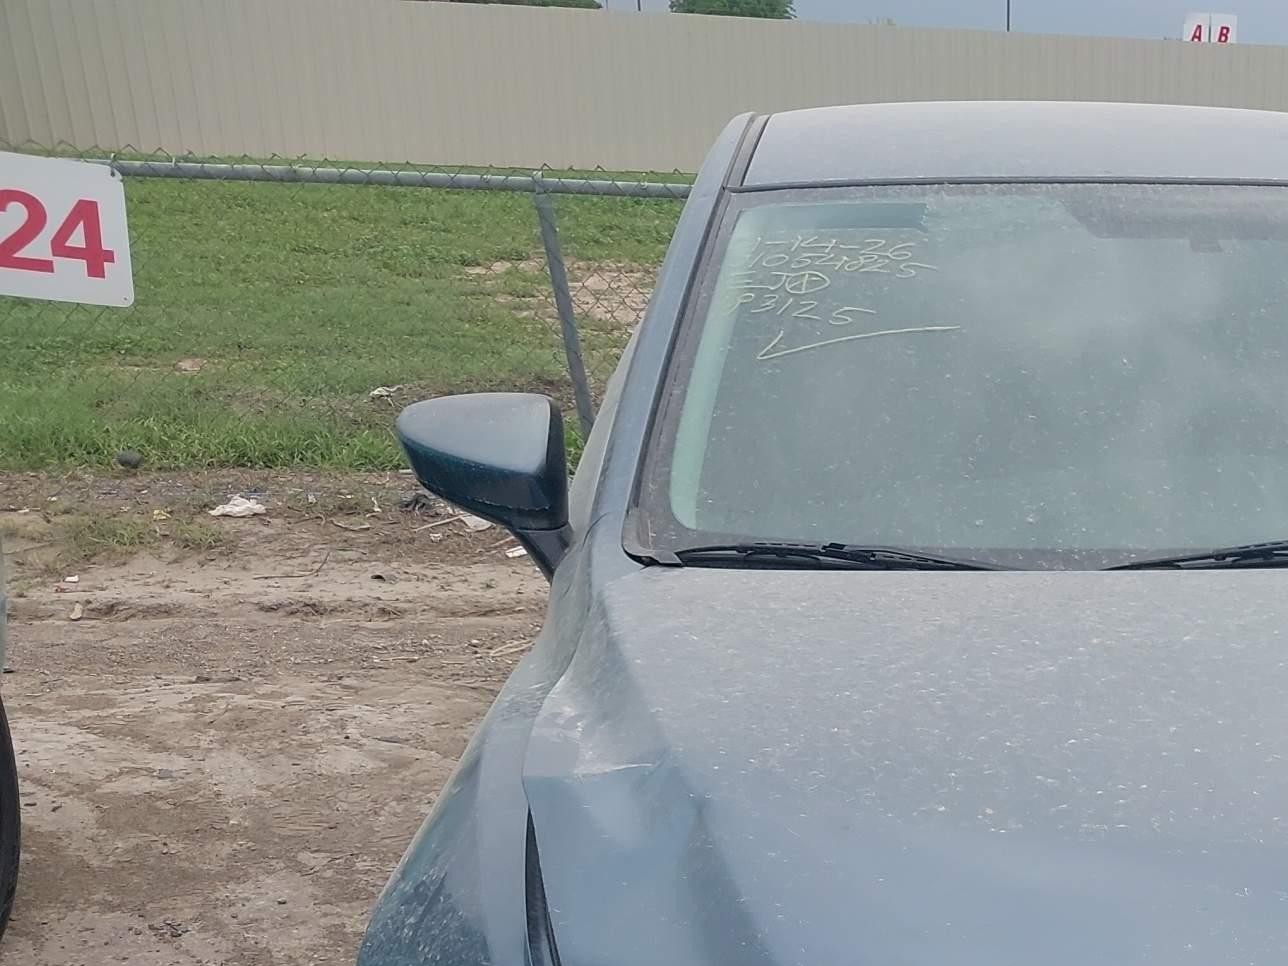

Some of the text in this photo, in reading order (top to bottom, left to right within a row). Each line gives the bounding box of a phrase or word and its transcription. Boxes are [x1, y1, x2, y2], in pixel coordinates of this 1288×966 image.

[1191, 24, 1202, 42] A
[1218, 26, 1230, 43] B
[0, 189, 115, 279] 24
